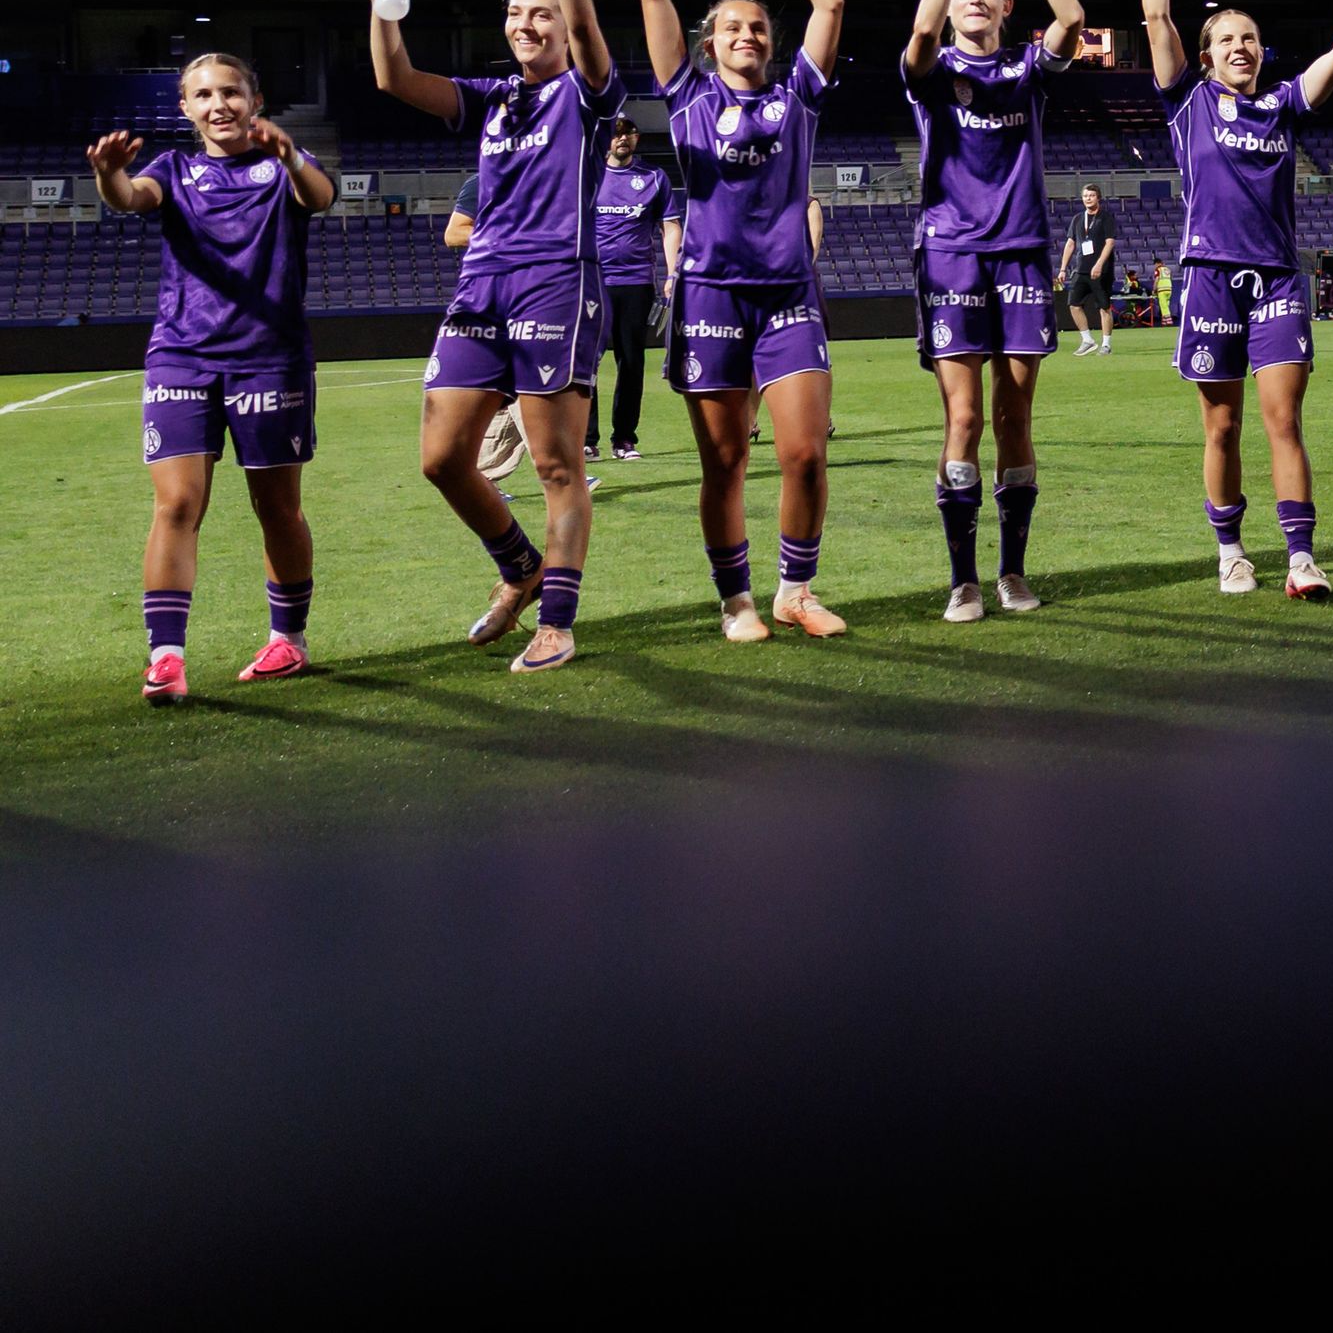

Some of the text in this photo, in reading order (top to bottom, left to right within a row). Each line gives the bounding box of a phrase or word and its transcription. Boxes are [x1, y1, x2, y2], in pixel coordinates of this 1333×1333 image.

[956, 108, 1025, 130] Verbun
[1213, 126, 1288, 153] Verbund
[840, 173, 858, 183] 126
[37, 186, 59, 197] 122
[347, 181, 365, 192] 124
[1258, 299, 1288, 323] VIE
[440, 322, 498, 340] rbund
[537, 323, 566, 333] Vienna
[534, 331, 564, 342] Airport
[236, 390, 278, 415] VIE
